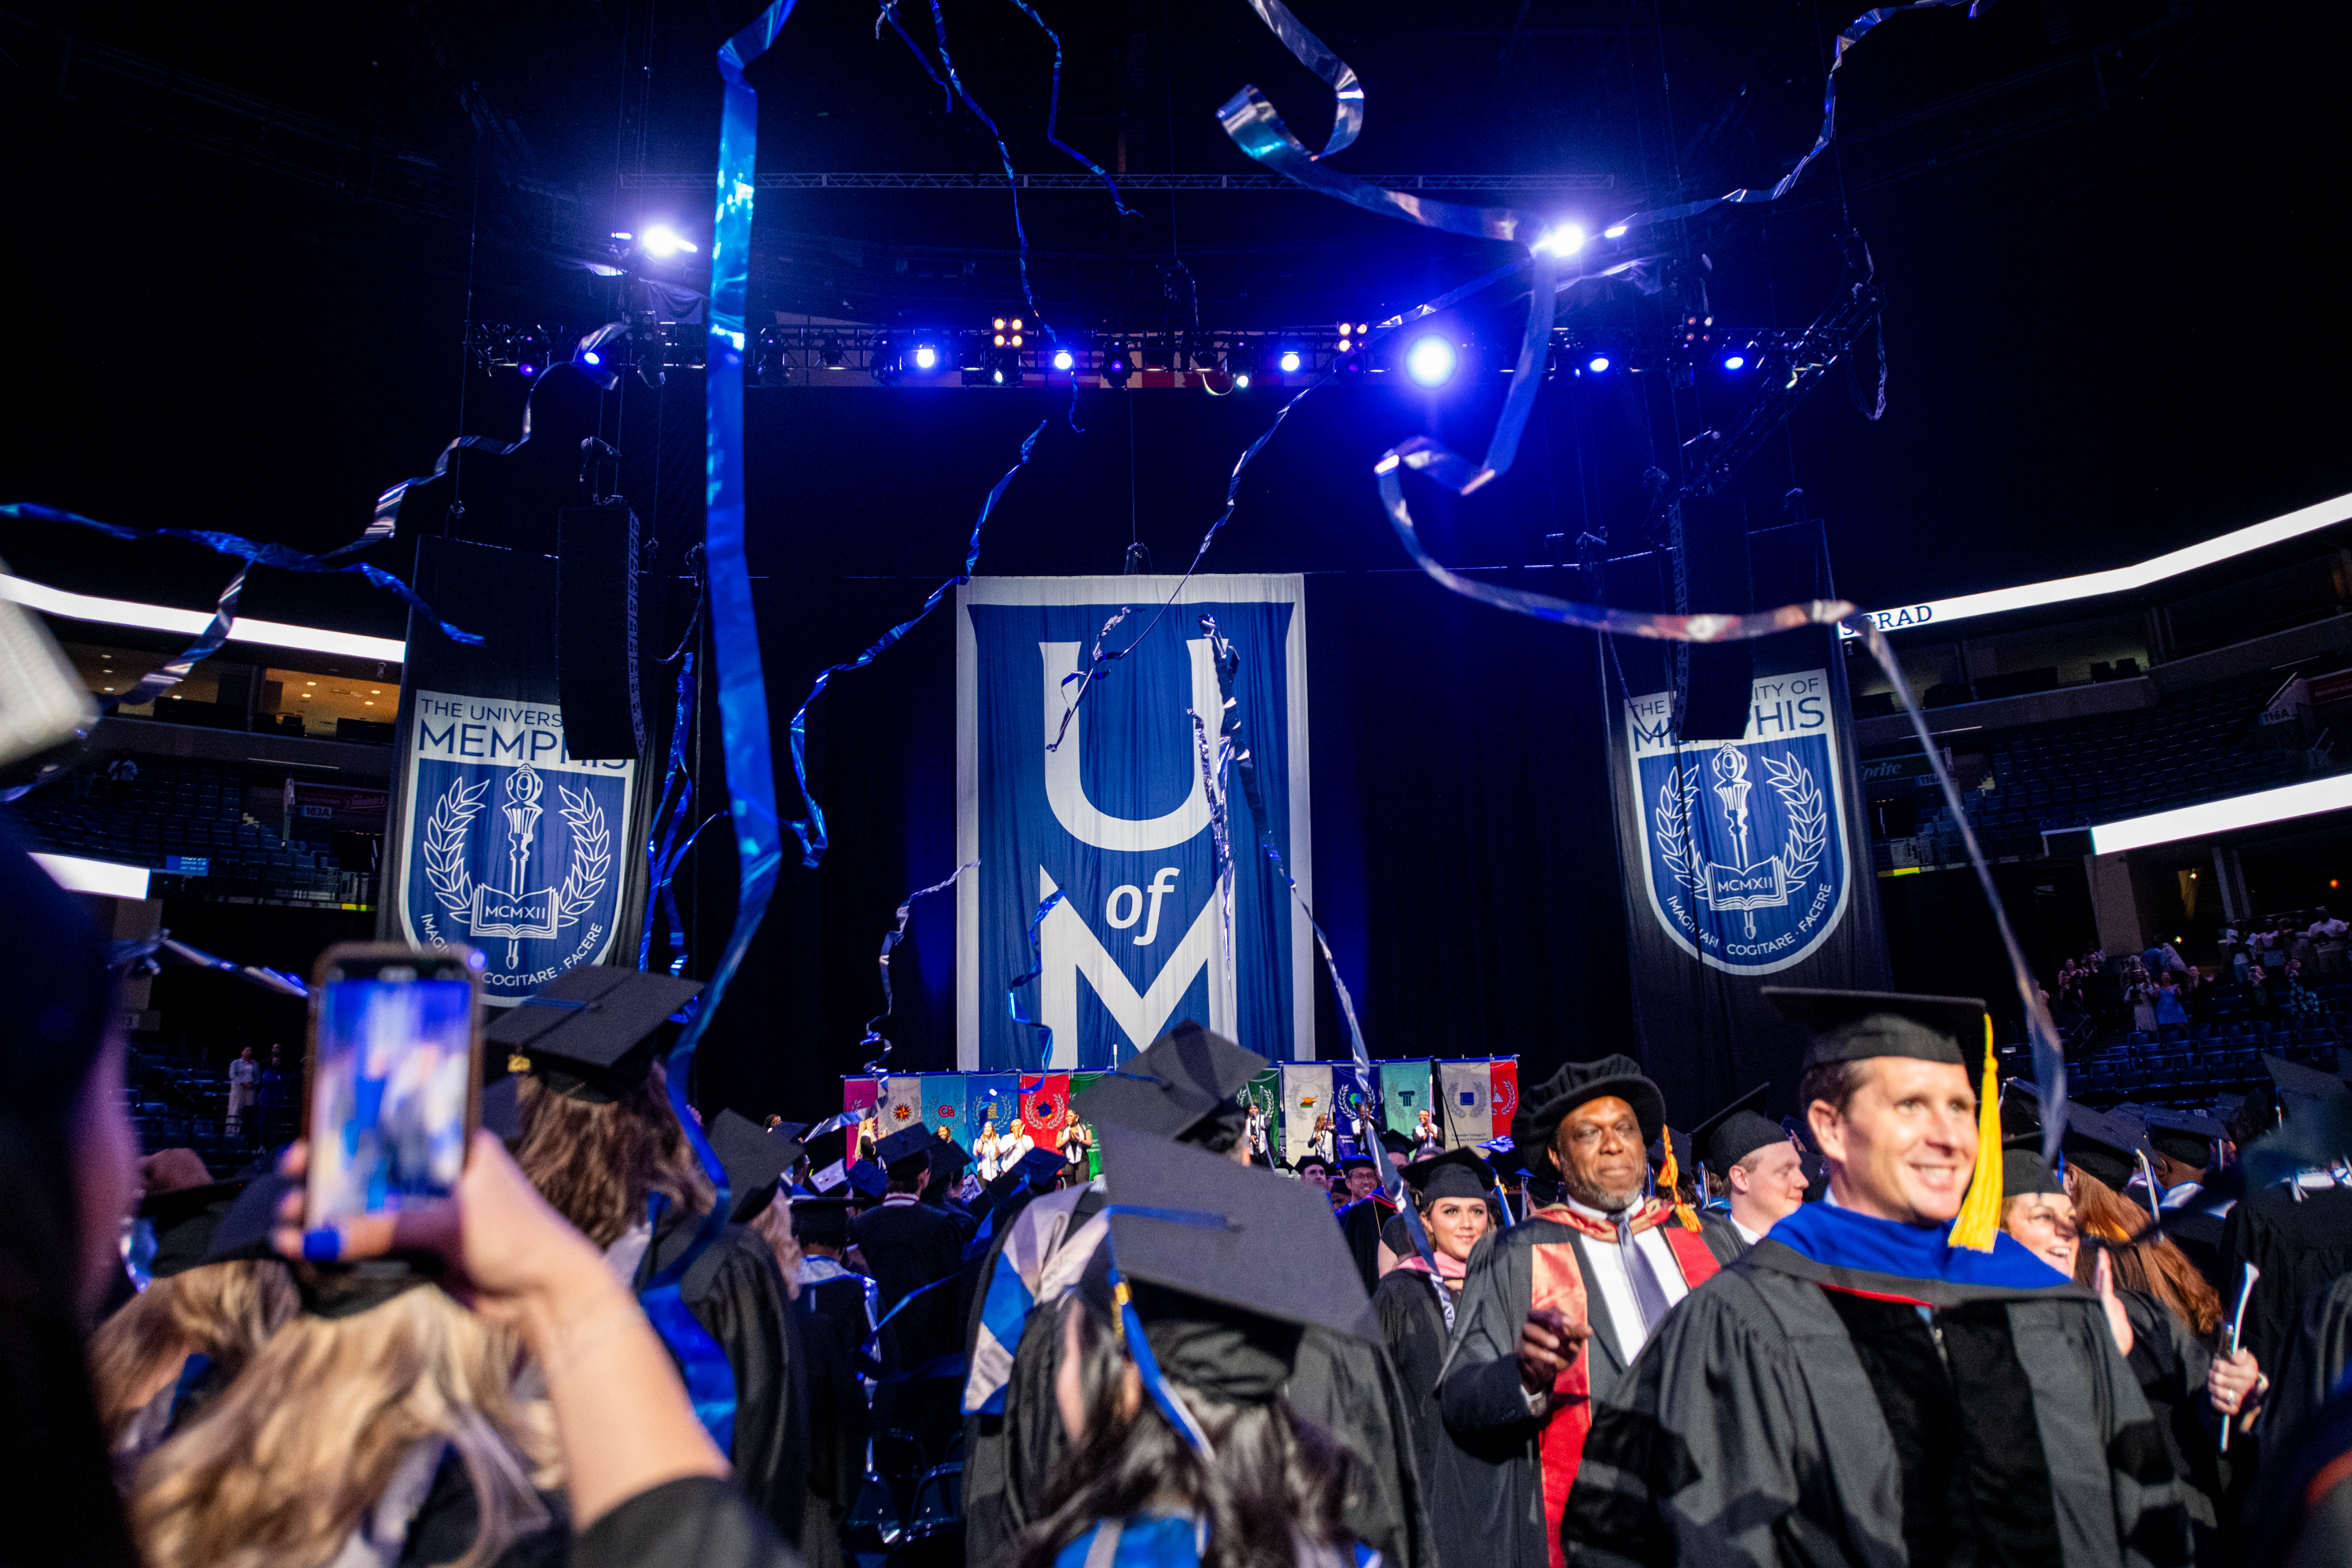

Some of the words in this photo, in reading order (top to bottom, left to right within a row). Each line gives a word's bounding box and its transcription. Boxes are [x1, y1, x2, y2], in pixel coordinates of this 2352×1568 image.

[421, 699, 462, 718] THE
[1629, 699, 1665, 716] THE
[1791, 678, 1818, 694] OF
[1038, 638, 1229, 851] U
[1860, 762, 1902, 782] prite
[1718, 877, 1773, 892] MCMXII
[485, 906, 545, 919] MCMXII
[1106, 867, 1180, 946] of
[1727, 932, 1796, 955] COGITARE
[1798, 883, 1831, 932] FACERE
[482, 966, 558, 987] COGITARE
[563, 923, 603, 969] FACERE
